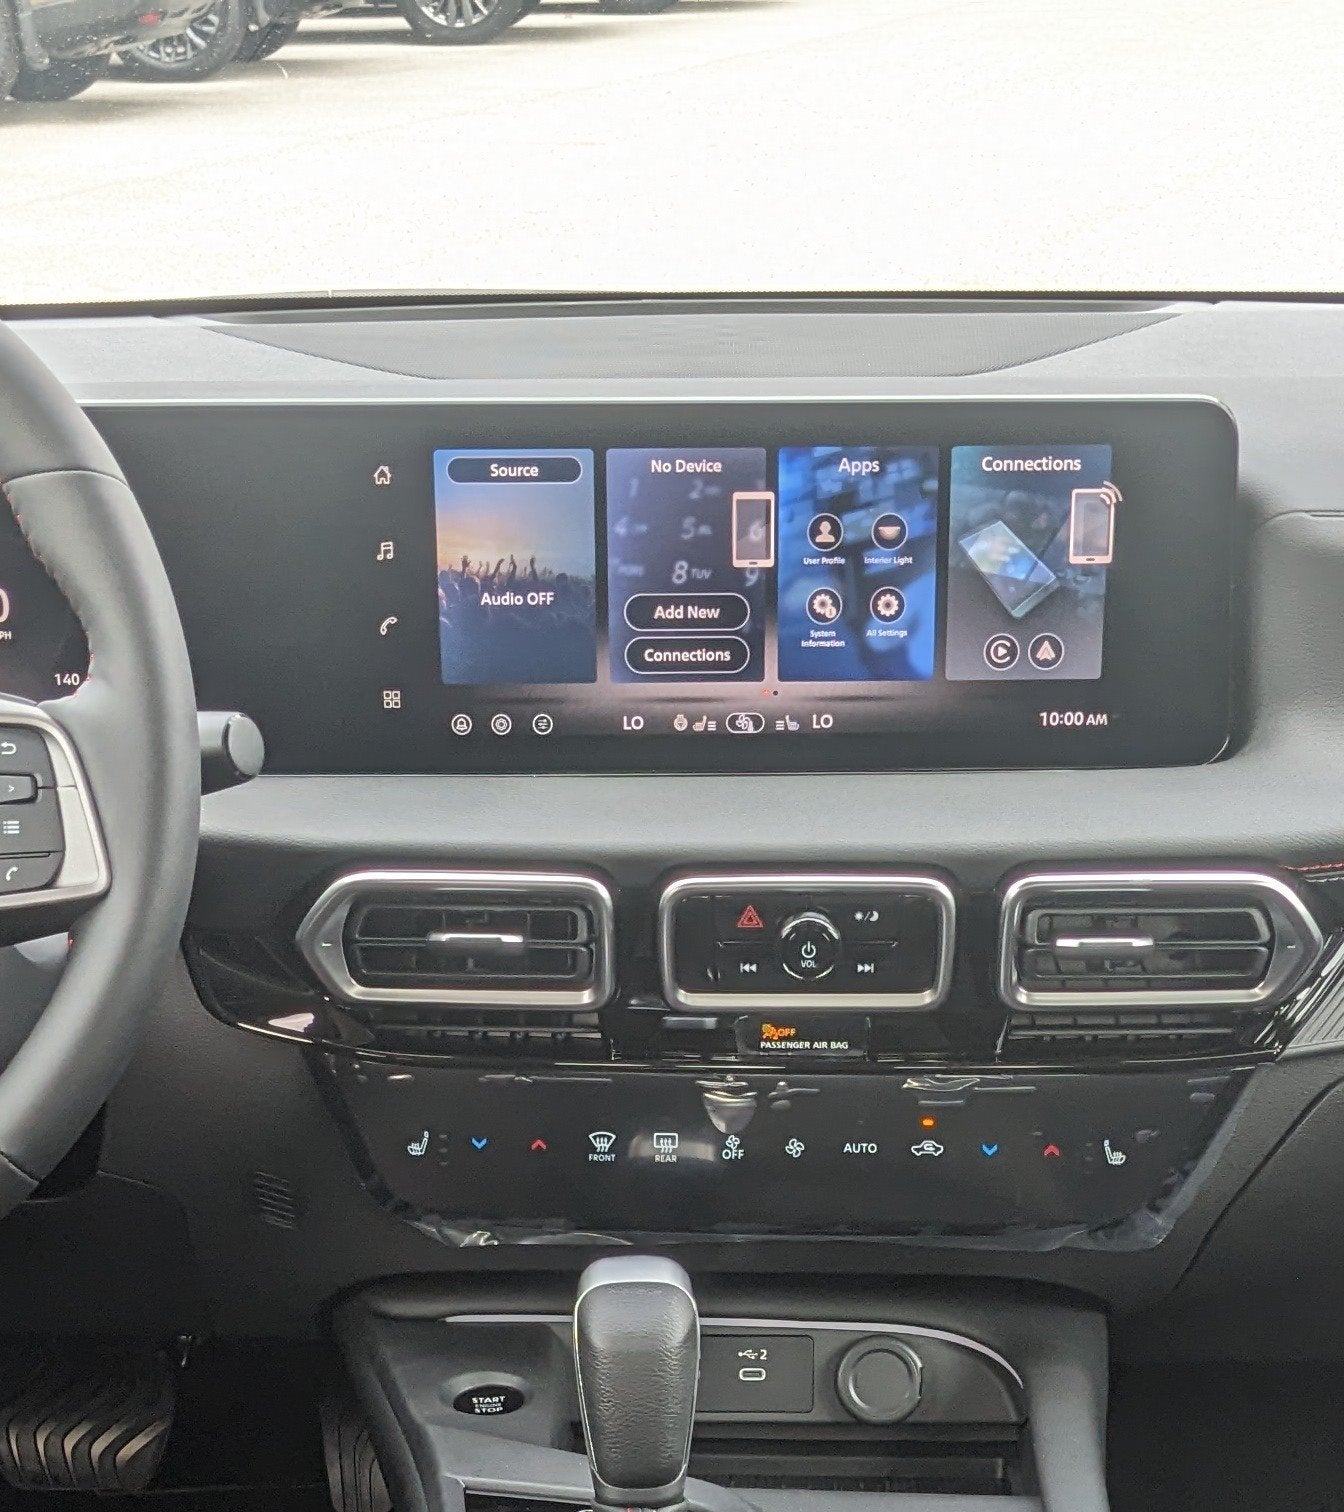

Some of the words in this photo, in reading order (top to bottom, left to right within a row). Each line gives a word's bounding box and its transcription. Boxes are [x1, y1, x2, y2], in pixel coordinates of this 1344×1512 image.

[651, 460, 671, 474] No
[674, 459, 722, 474] Device
[838, 457, 880, 475] Apps
[982, 455, 1082, 473] Connections
[490, 463, 539, 477] Source
[803, 556, 820, 565] User
[821, 556, 846, 565] Profile
[893, 556, 913, 566] Light
[481, 591, 524, 607] Audio
[527, 591, 555, 606] OFF
[654, 605, 684, 619] Add
[687, 606, 720, 619] New
[810, 630, 836, 638] System
[866, 629, 877, 637] All
[877, 629, 908, 638] Settings
[801, 640, 845, 648] Information
[644, 648, 731, 662] Connections
[54, 673, 80, 686] 140
[623, 716, 644, 731] LO
[812, 714, 833, 730] LO
[1039, 712, 1084, 728] 10:00
[1086, 714, 1108, 727] AM
[800, 959, 817, 969] VOL
[760, 1041, 810, 1049] PASSENGER
[812, 1041, 828, 1049] AIR
[830, 1041, 849, 1050] BAG
[843, 1142, 878, 1154] AUTO
[588, 1153, 616, 1162] FRONT
[654, 1154, 677, 1163] REAR
[722, 1149, 744, 1160] OFF
[760, 1349, 768, 1360] 2
[471, 1396, 506, 1404] START
[474, 1406, 504, 1414] STOP
